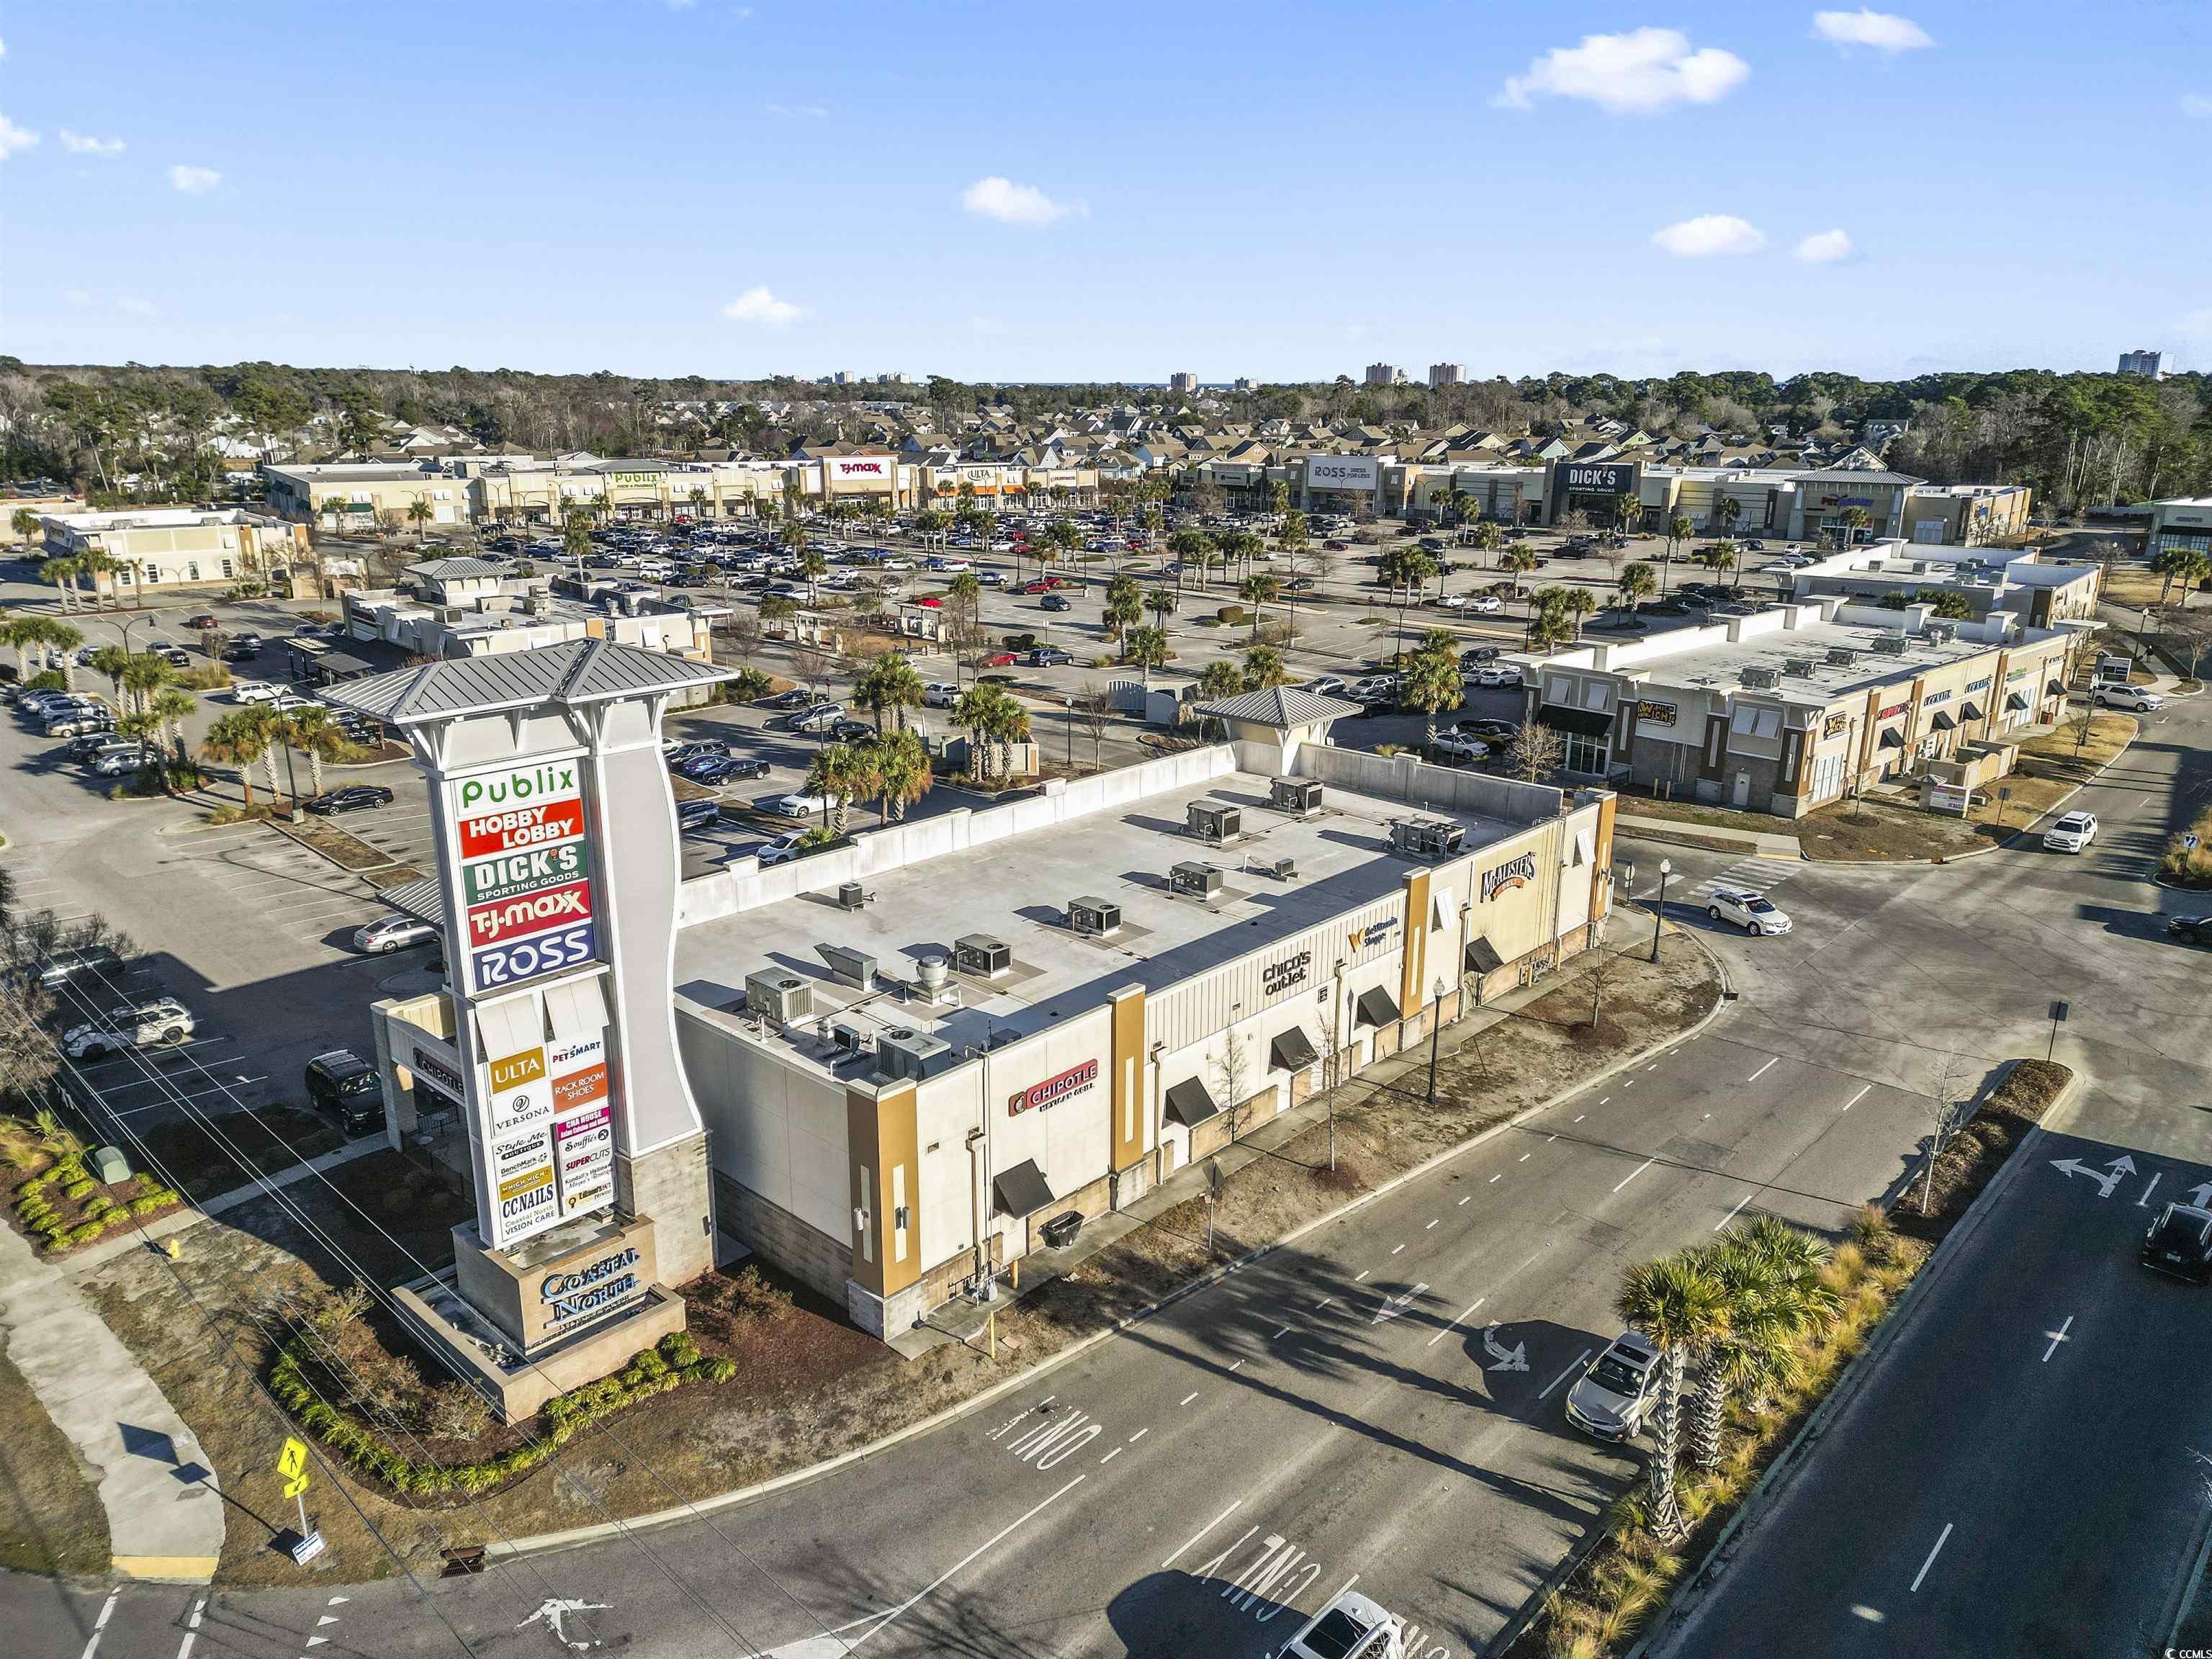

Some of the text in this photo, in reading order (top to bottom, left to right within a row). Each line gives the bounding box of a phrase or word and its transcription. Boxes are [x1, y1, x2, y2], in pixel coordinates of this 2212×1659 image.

[616, 472, 657, 482] Publix
[970, 469, 991, 479] ULTA
[1315, 467, 1346, 477] ROSS
[1569, 469, 1617, 485] DICK'S
[462, 766, 575, 808] Publix
[469, 806, 548, 837] HOBBY
[502, 818, 574, 850] LOBBY
[474, 845, 578, 891] DICK'S
[477, 871, 579, 901] SPORTING GOODS
[481, 929, 589, 986] ROSS
[1265, 967, 1306, 996] outlet
[421, 1061, 464, 1093] CHIPOTLE
[495, 1058, 541, 1084] ULTA
[555, 1071, 604, 1094] RACK ROOM
[567, 1084, 594, 1100] SHOES
[1031, 1065, 1097, 1104] CHIPOTLE
[496, 1106, 549, 1130] VERSONA
[566, 1110, 602, 1128] CHA HOUSE
[495, 1132, 547, 1155] Style Me
[565, 1147, 611, 1171] SUPERCUTS
[501, 1179, 525, 1192] WHICH
[505, 1210, 555, 1235] VISION CARE
[534, 1205, 554, 1216] North
[542, 1248, 640, 1299] COASTAL
[554, 1274, 635, 1321] NORTH
[1191, 1526, 1321, 1622] ONLY
